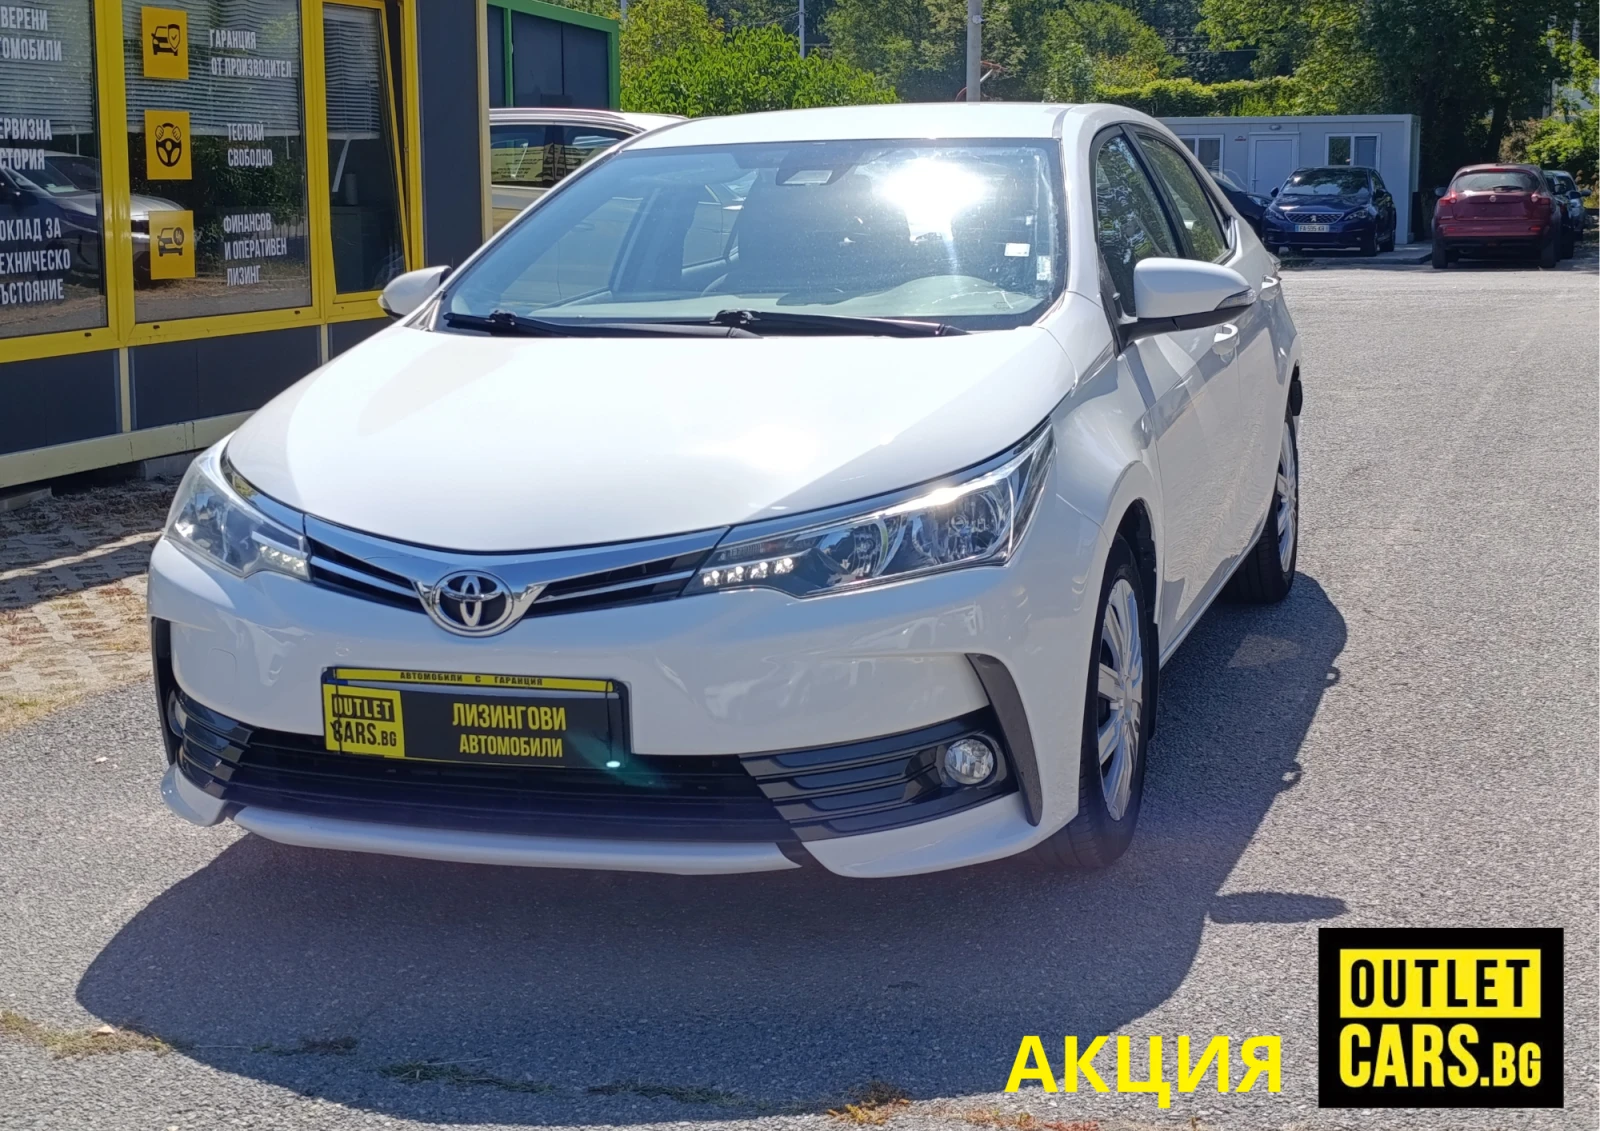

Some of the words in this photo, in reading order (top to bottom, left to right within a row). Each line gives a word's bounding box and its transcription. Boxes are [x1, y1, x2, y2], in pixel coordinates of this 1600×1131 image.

[1, 6, 48, 31] ВЕРЕНИ
[0, 37, 62, 61] ОМОБИЛИ
[210, 29, 256, 50] ГАРАНЦИЯ
[211, 57, 221, 76] ОТ
[225, 57, 292, 78] ПРОИЗВОДИТЕЛ
[227, 120, 265, 142] ТЕСТВАЙ
[227, 149, 273, 168] СВОБОДНО
[45, 217, 62, 238] ЗА
[223, 212, 272, 234] ФИНАНСОВ
[224, 241, 231, 260] И
[232, 237, 288, 260] ОПЕРАТИВЕН
[226, 265, 262, 287] ЛИЗИНГ
[400, 671, 463, 682] АВТОМОБИЛИ
[474, 675, 482, 683] С
[493, 676, 543, 687] ГАРАНЦИЯ
[333, 697, 391, 720] OUTLET
[452, 702, 567, 731] ЛИЗИНГОВИ
[333, 719, 397, 747] CARS.BG
[458, 733, 564, 758] АВТОМОБИЛИ
